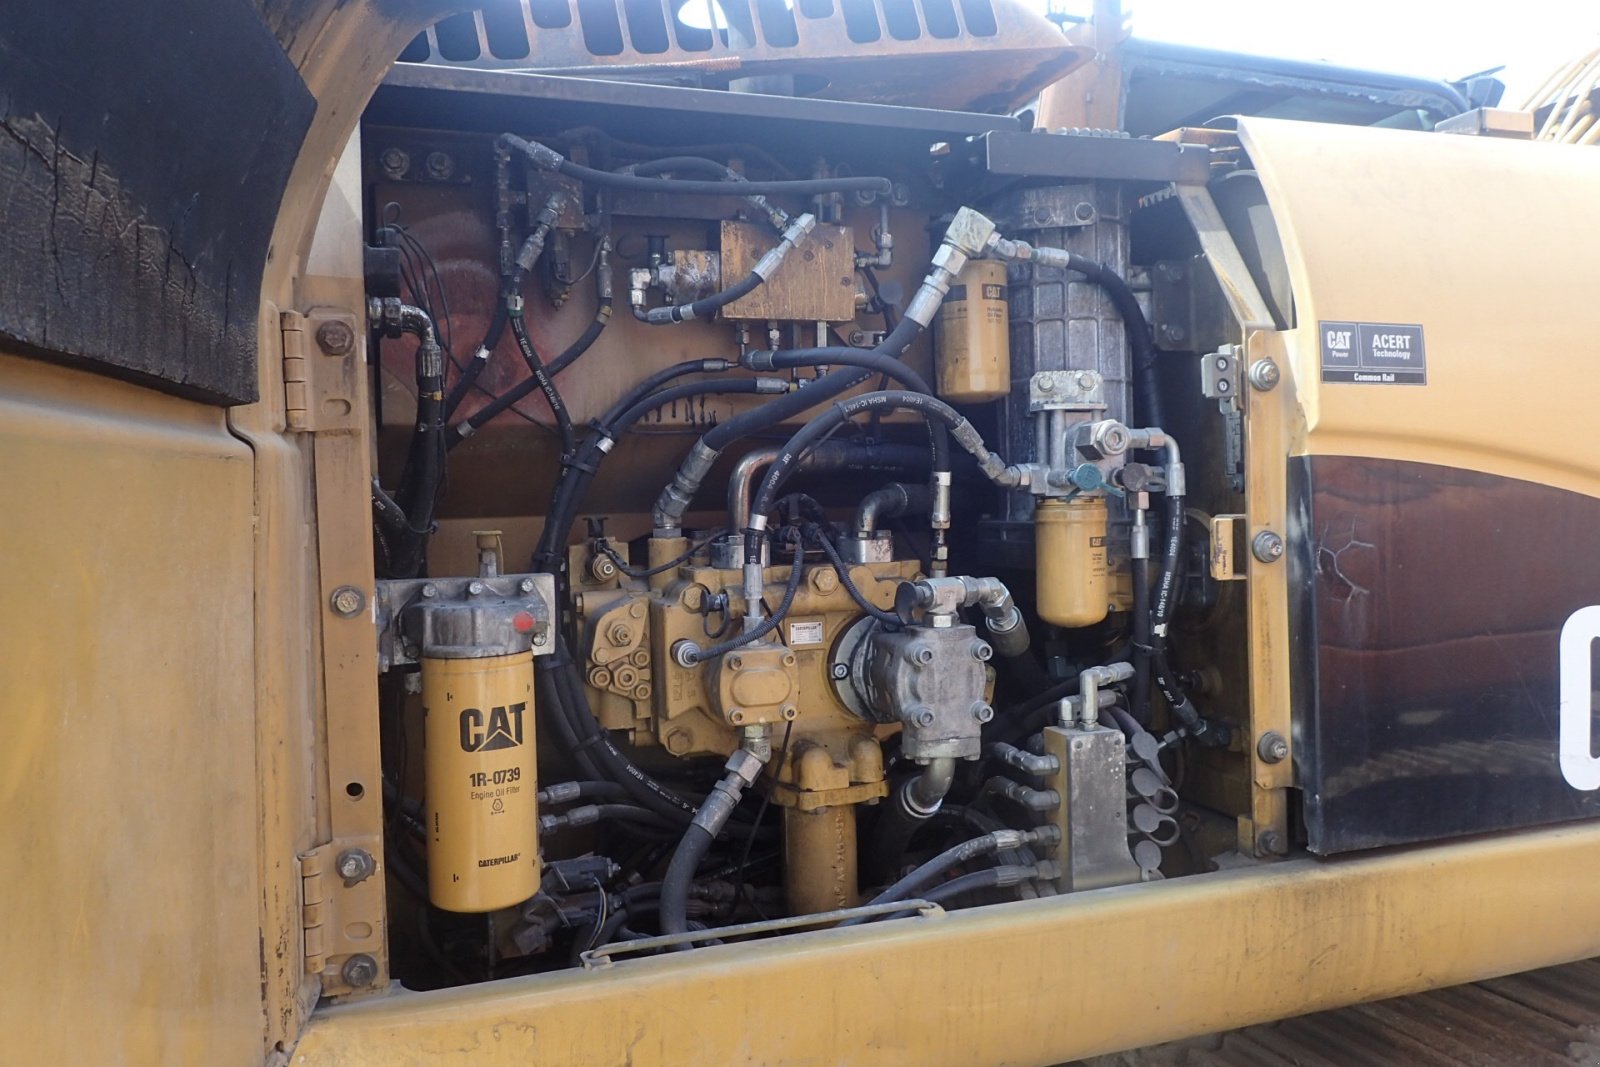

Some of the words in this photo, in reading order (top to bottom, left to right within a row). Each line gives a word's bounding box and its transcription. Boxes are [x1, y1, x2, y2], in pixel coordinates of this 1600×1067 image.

[1327, 331, 1352, 350] CAT
[1372, 334, 1411, 349] ACERT
[1332, 350, 1349, 358] Power
[1372, 348, 1411, 360] Technology
[1354, 372, 1381, 382] Common
[1382, 373, 1395, 382] Rail
[1161, 571, 1172, 592] MSHA
[459, 702, 526, 752] CAT
[469, 766, 521, 787] 1R-0739
[470, 791, 494, 801] Engine
[495, 788, 505, 797] Oil
[506, 786, 520, 795] Filter
[478, 853, 520, 867] CATERPILLAR
